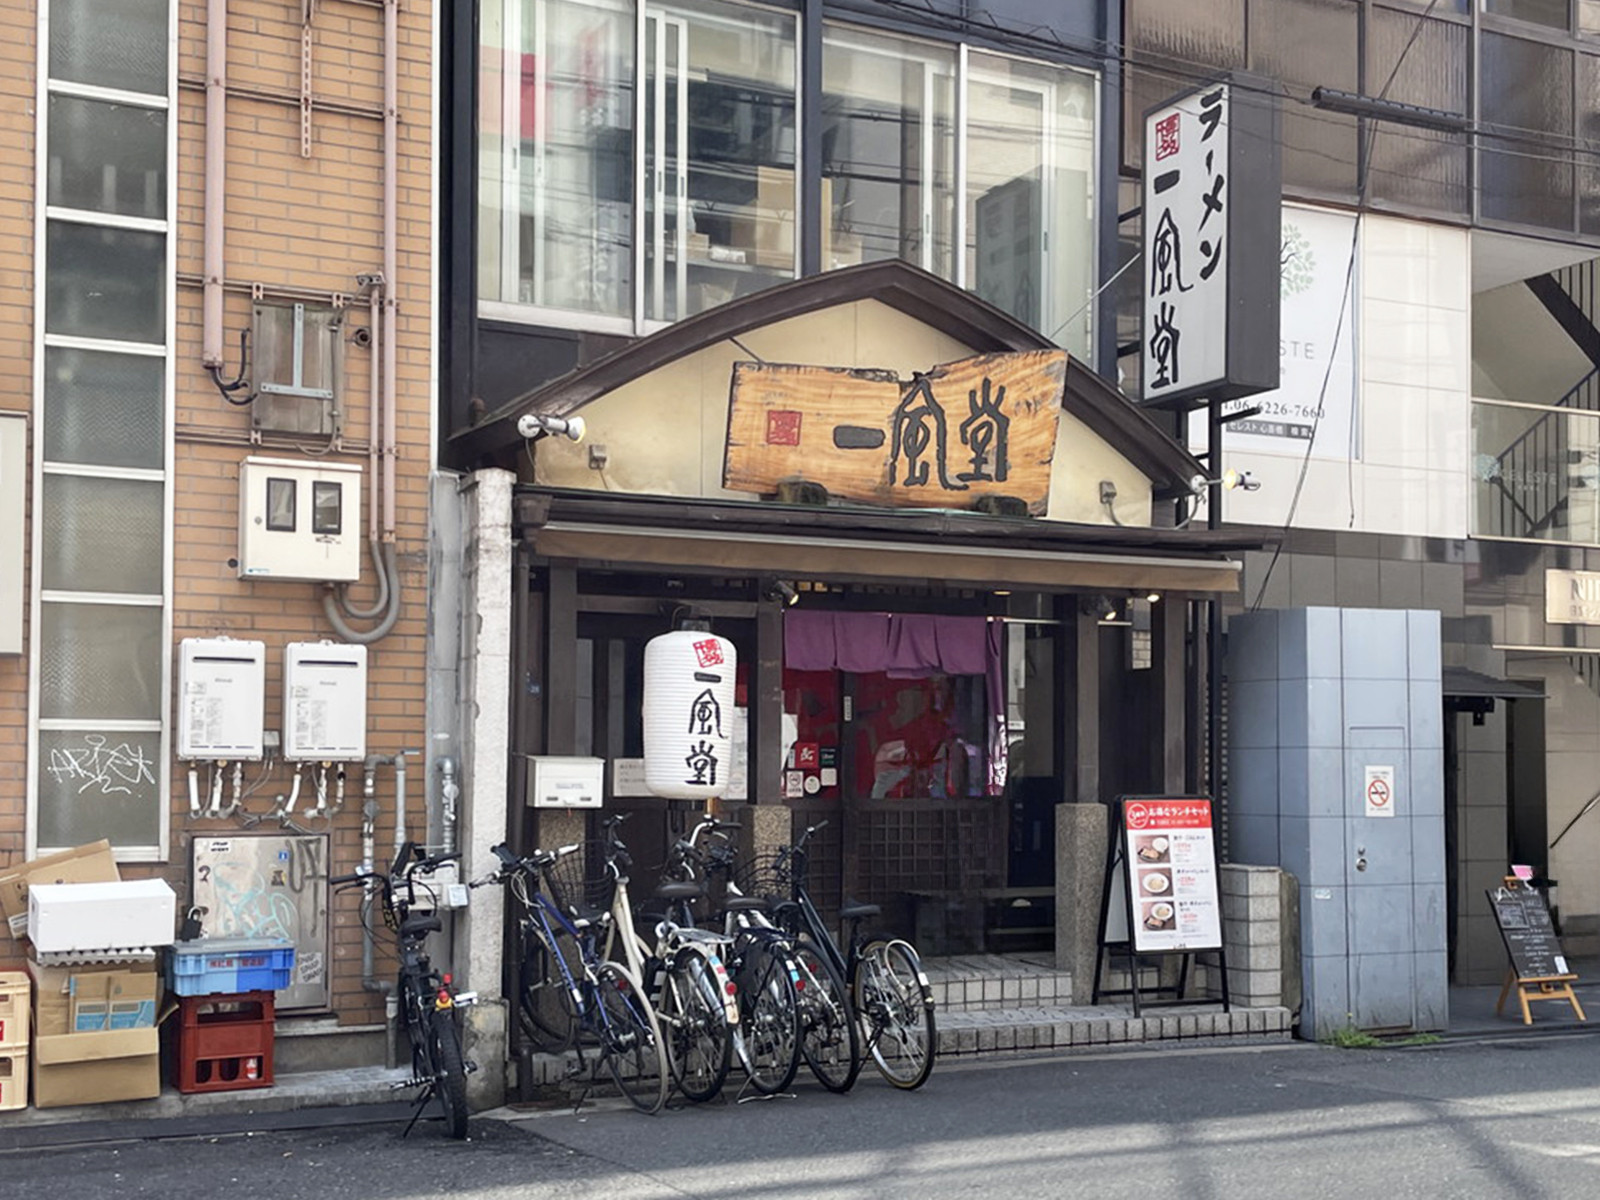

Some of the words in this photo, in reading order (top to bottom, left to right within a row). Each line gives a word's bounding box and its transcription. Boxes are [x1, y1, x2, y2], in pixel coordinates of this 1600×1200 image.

[1199, 88, 1227, 281] ラーメン
[1150, 169, 1194, 390] 一風堂
[832, 377, 1010, 491] 一風堂
[684, 670, 729, 787] 一風堂
